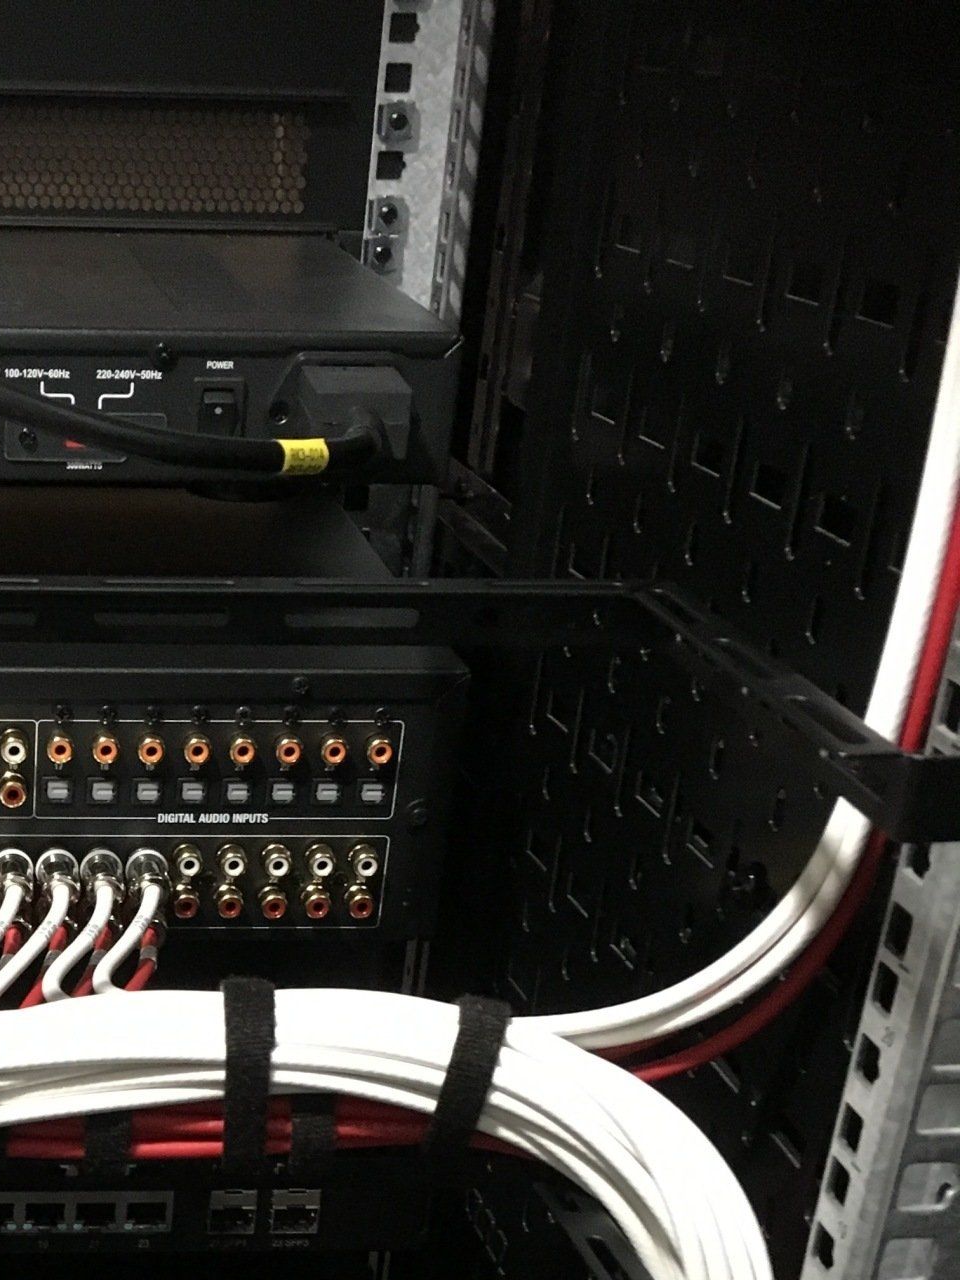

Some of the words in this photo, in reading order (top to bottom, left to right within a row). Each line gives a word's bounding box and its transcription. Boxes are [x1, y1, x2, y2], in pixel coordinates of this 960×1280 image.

[206, 361, 235, 370] POWER
[157, 813, 196, 824] DIGITAL
[198, 813, 230, 824] AUDIO
[232, 813, 269, 824] INPUTS
